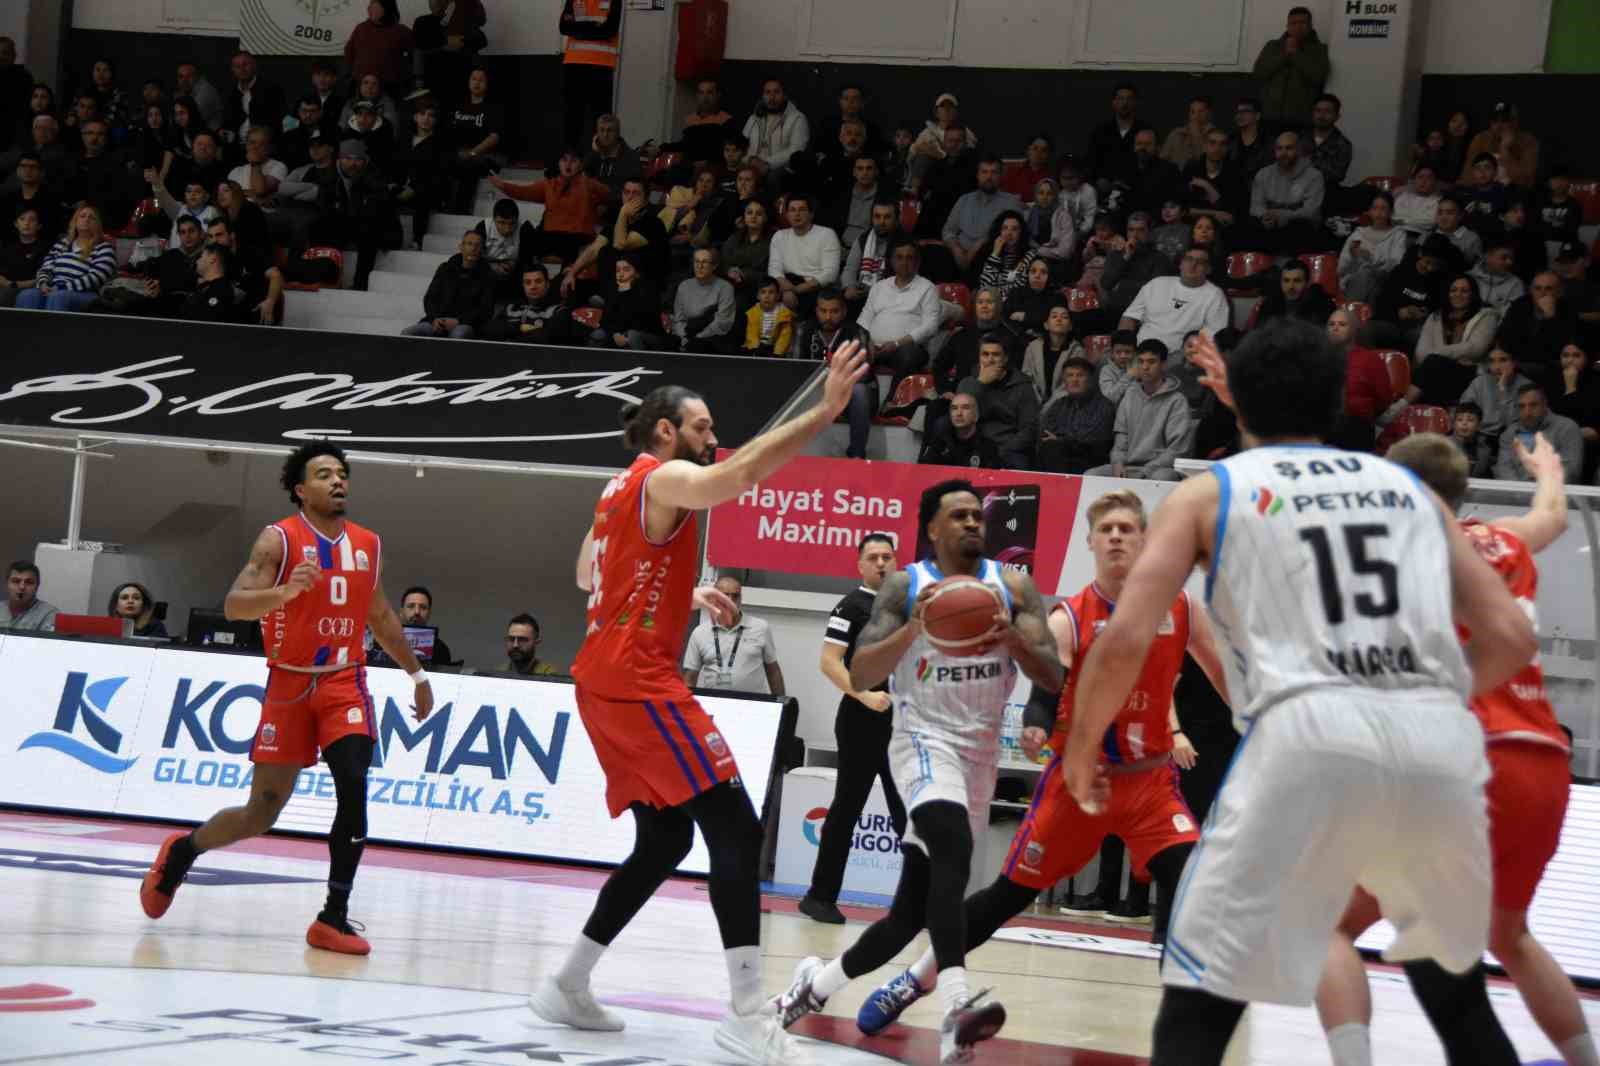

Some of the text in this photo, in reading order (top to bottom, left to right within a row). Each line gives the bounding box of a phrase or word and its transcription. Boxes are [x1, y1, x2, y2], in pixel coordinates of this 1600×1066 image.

[1345, 0, 1397, 14] H BLOK
[294, 24, 332, 41] 2008
[738, 483, 902, 518] Hayat Sana
[330, 576, 347, 605] 0
[1299, 523, 1399, 625] 15
[275, 603, 286, 648] LOTU
[161, 677, 571, 784] KOMAN
[153, 757, 257, 790] GLOBA
